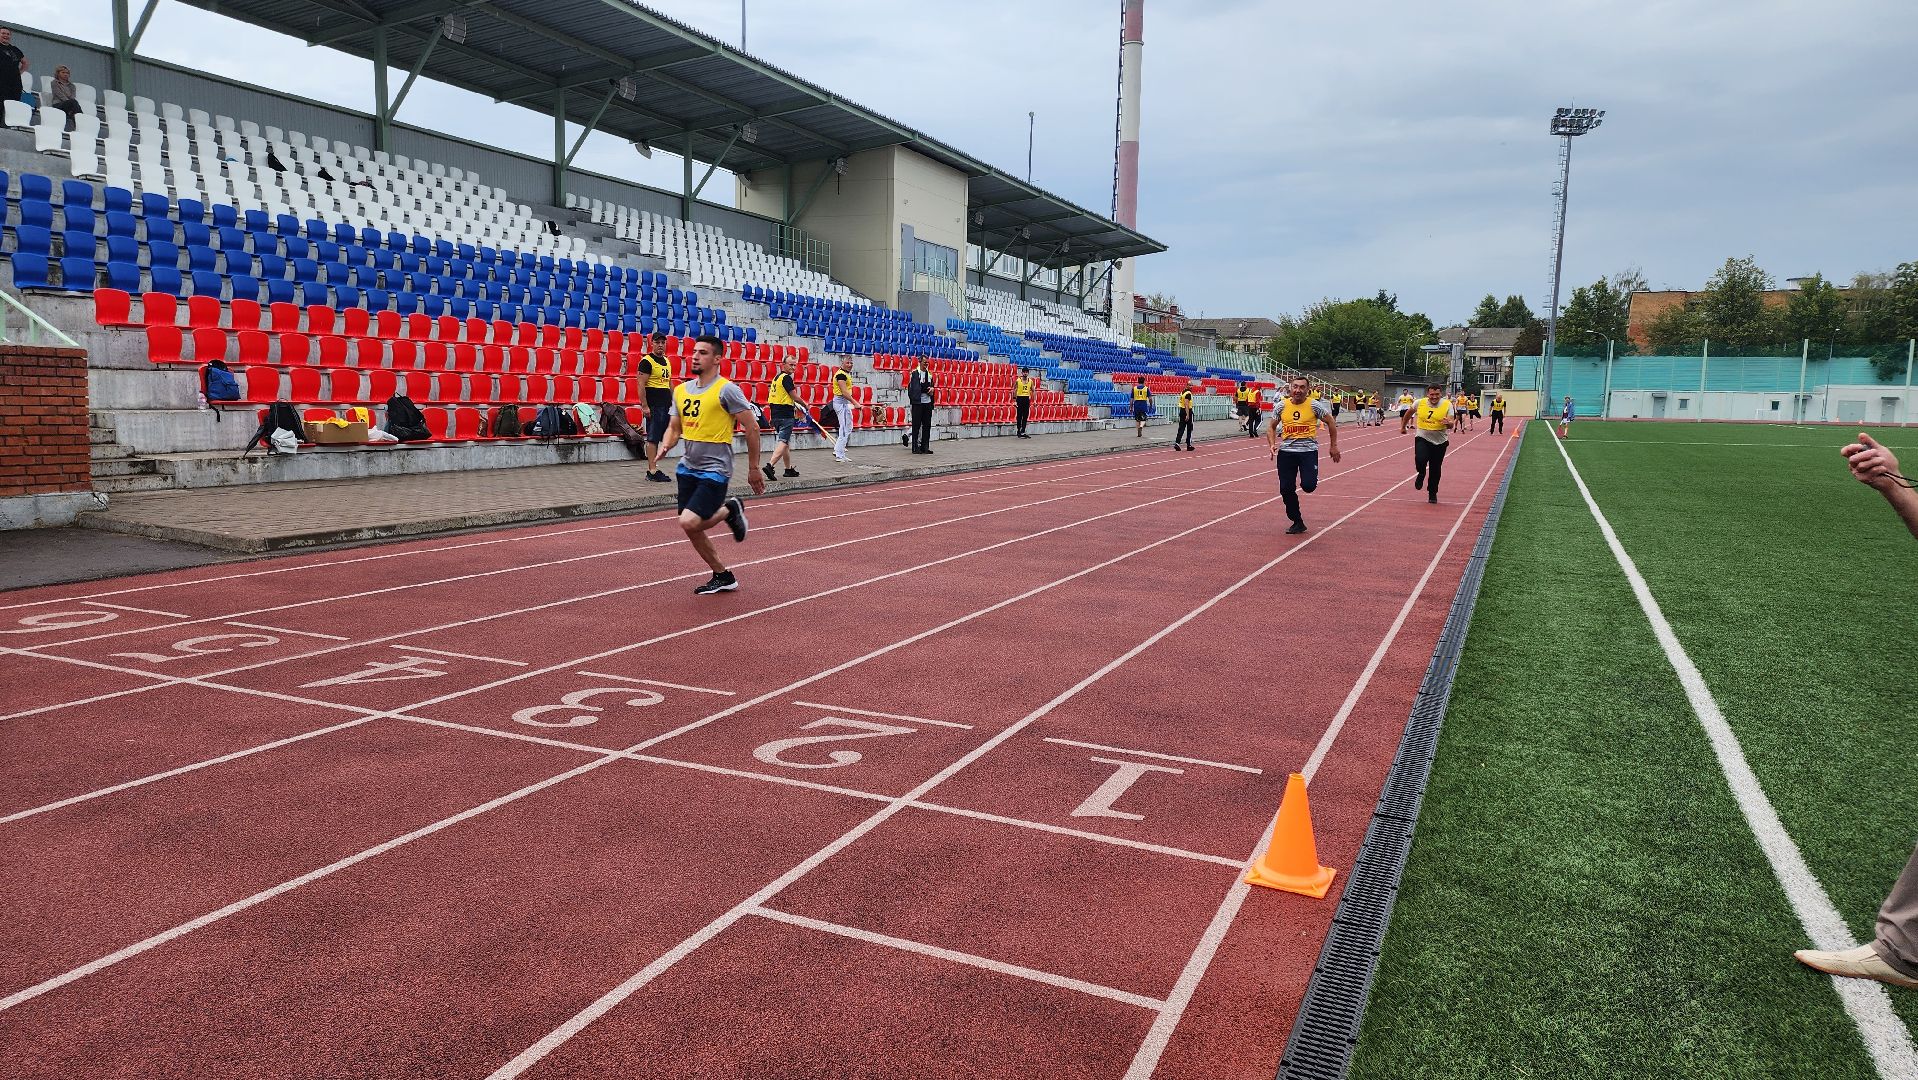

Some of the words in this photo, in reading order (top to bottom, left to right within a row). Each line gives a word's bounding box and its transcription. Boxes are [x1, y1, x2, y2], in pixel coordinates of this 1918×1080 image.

[682, 398, 701, 418] 23
[1292, 410, 1301, 421] 9
[1427, 410, 1434, 420] 7
[107, 633, 281, 664] 5
[297, 655, 449, 689] 4
[511, 687, 665, 728] 3
[752, 716, 918, 770] 2
[1070, 756, 1184, 821] 1
